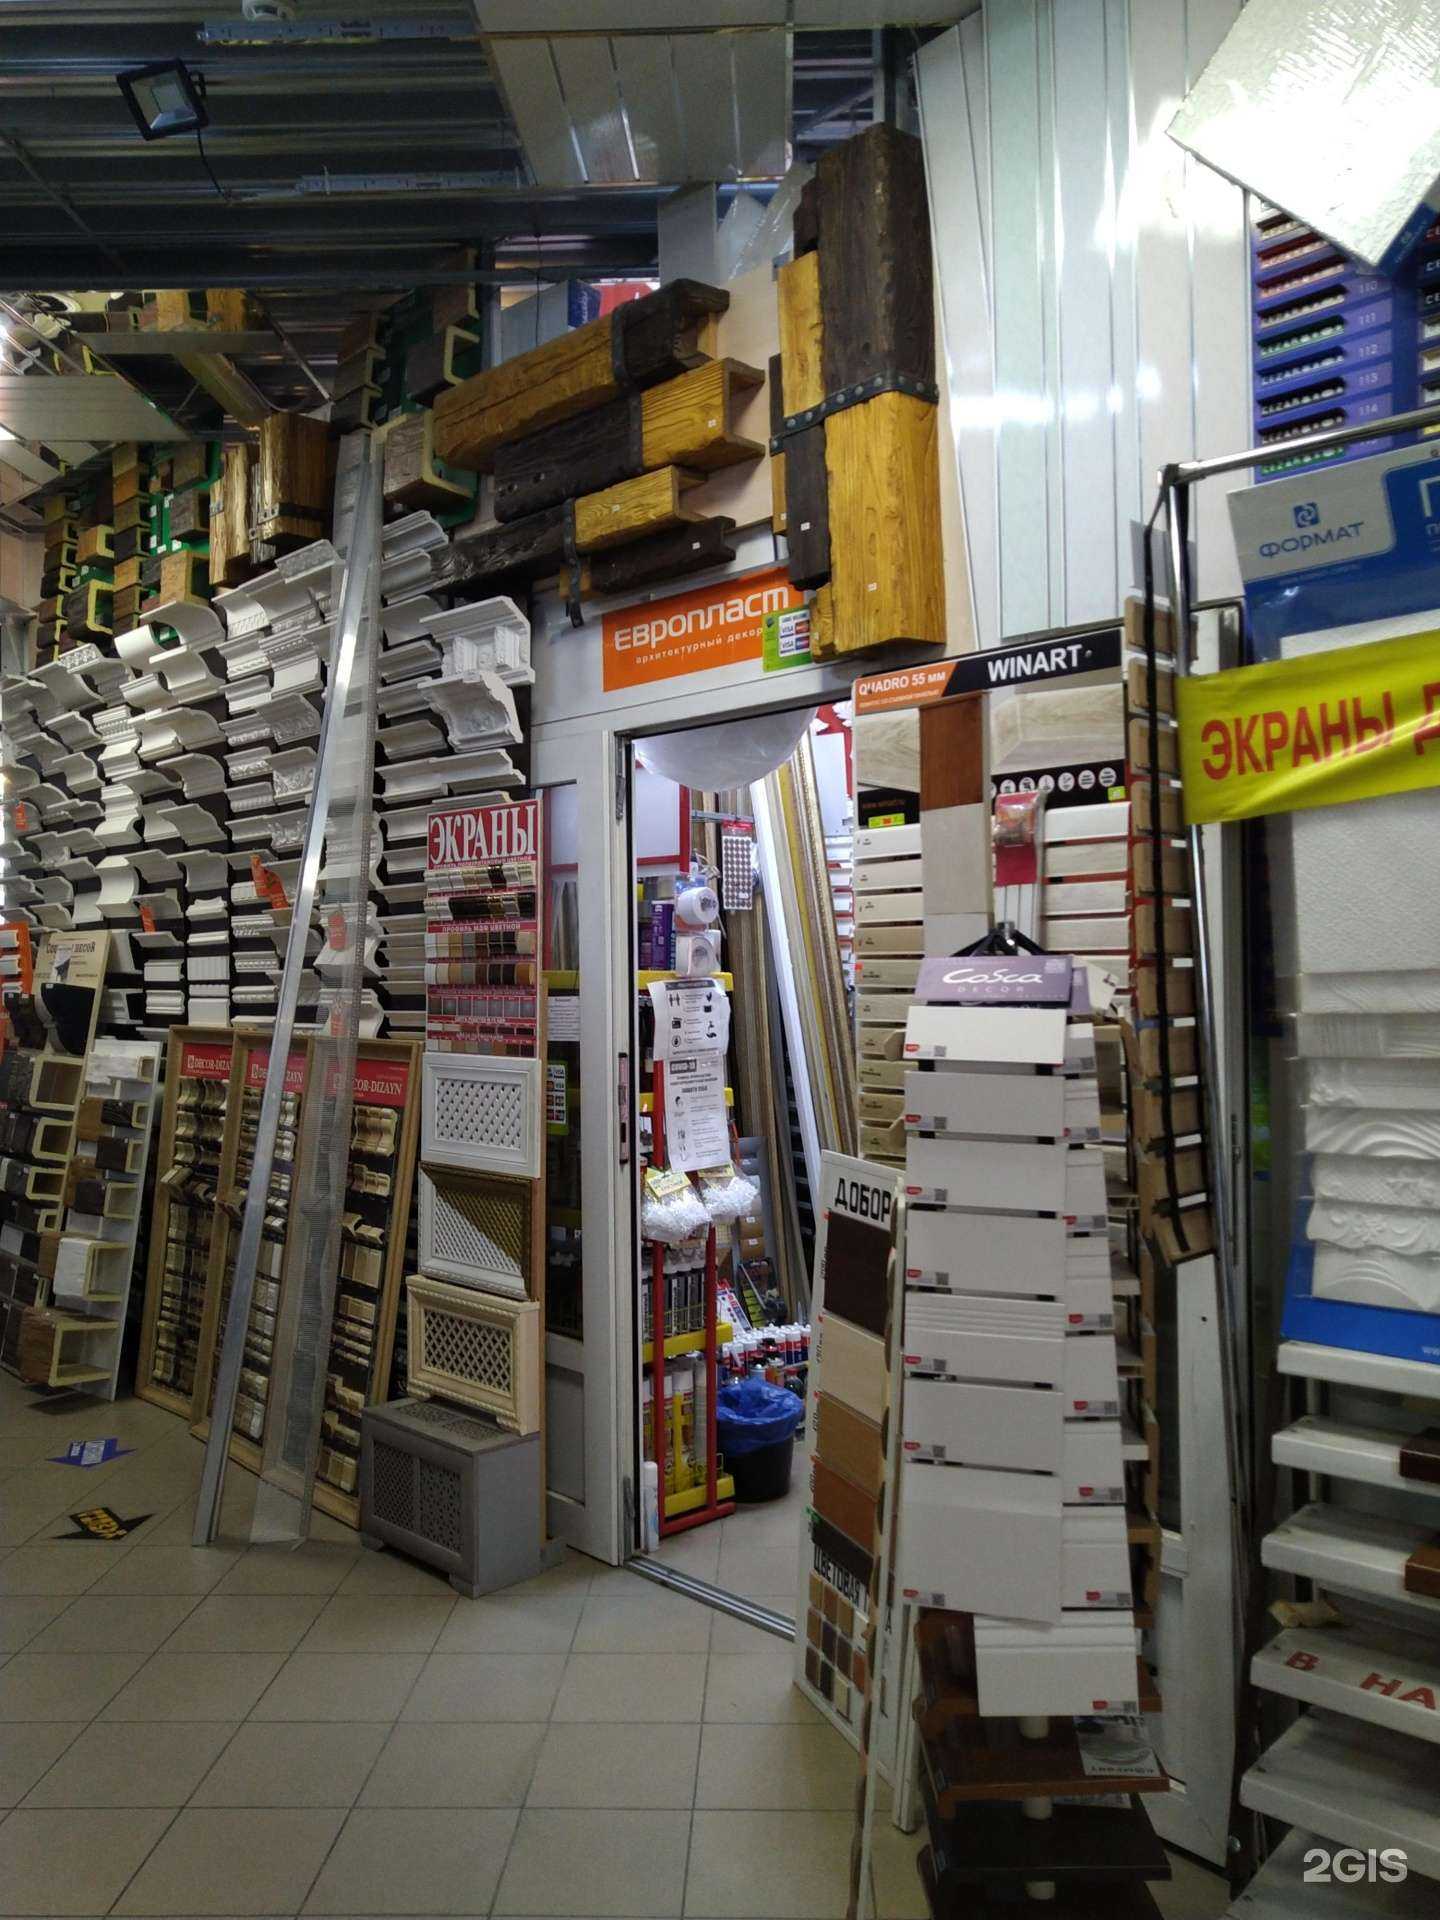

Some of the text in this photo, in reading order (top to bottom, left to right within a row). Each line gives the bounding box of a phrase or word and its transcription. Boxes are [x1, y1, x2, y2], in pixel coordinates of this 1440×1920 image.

[859, 675, 909, 696] QUADRO
[911, 672, 926, 687] 55
[987, 644, 1082, 683] WINART
[1201, 690, 1395, 780] ЭКРАНЫ
[430, 804, 537, 865] ЭКРАНЫ
[957, 985, 1024, 993] DECOR
[834, 1177, 892, 1222] ДОБОР
